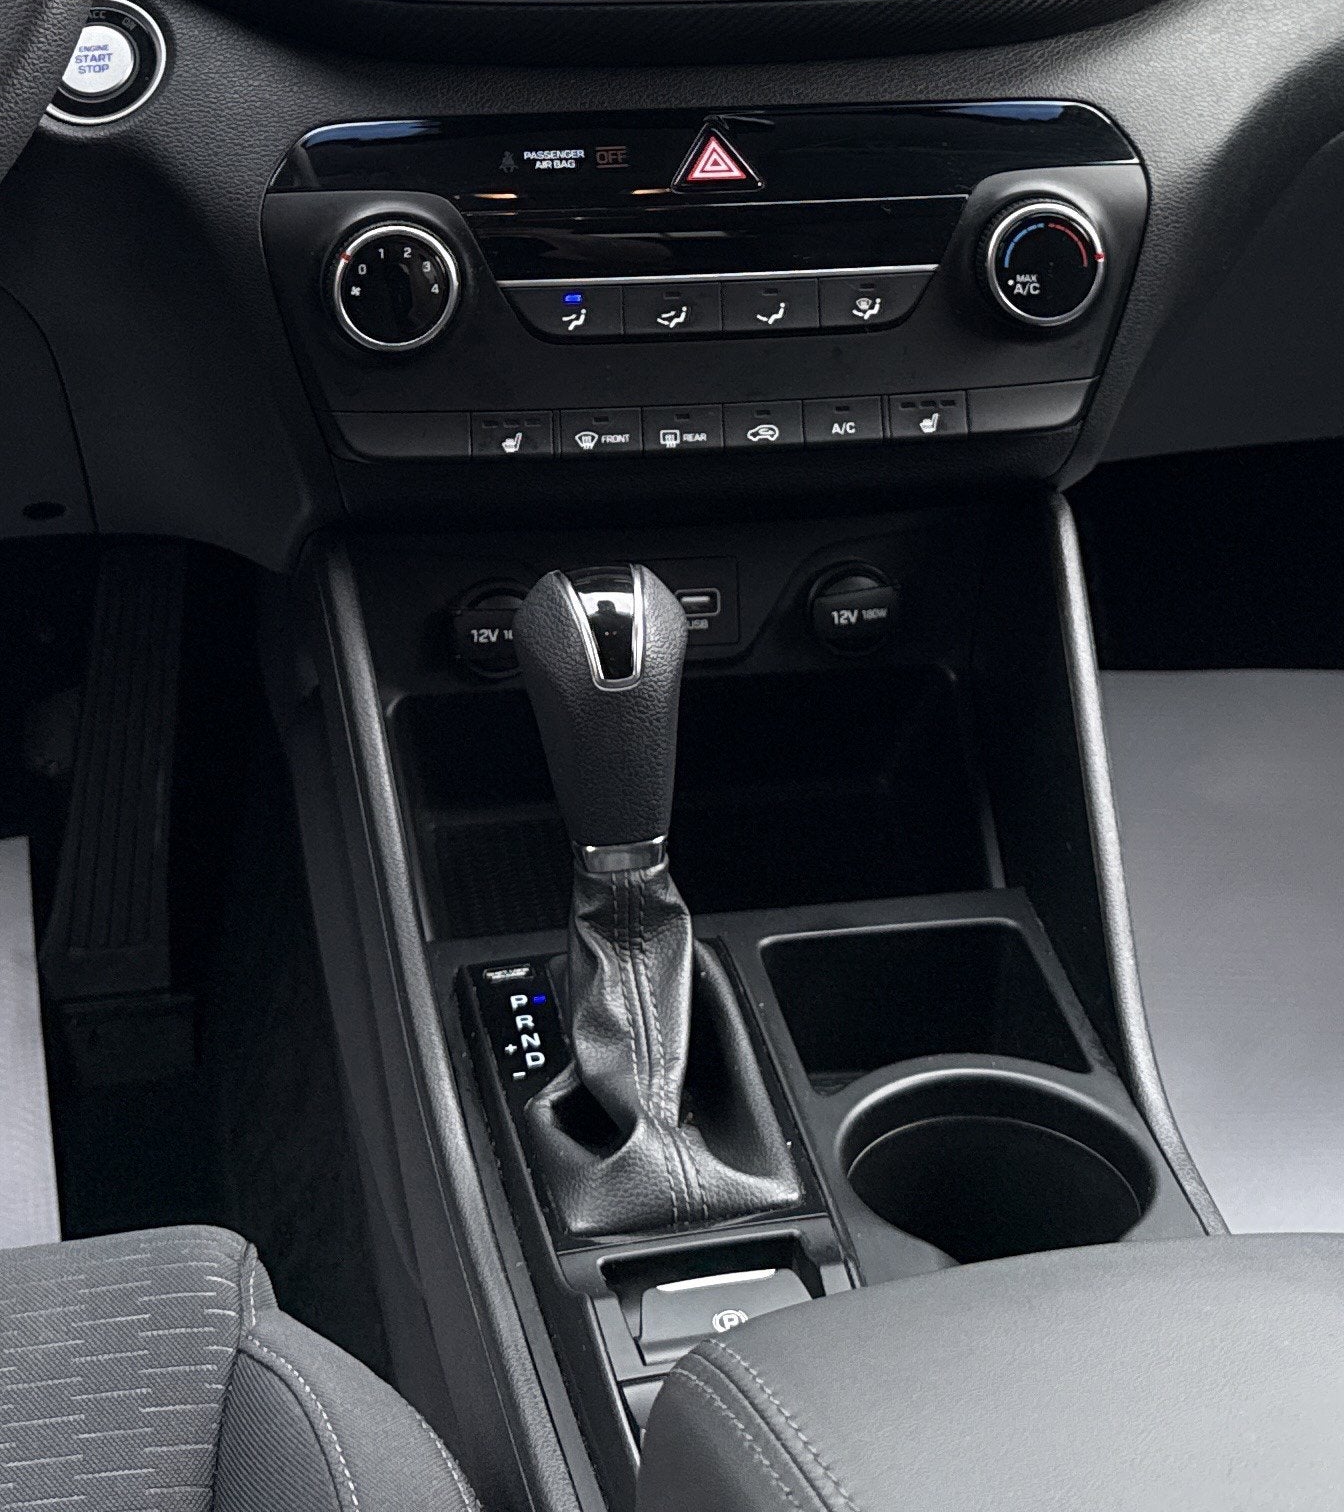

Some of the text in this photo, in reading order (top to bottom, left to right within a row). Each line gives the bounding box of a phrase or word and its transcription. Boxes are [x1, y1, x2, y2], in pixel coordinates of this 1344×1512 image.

[78, 44, 110, 53] ENGINE
[74, 53, 114, 64] START
[77, 63, 110, 75] STOP
[523, 149, 586, 160] PASSENGER
[595, 150, 626, 165] OFF
[534, 159, 576, 170] AIR BAG
[377, 247, 386, 260] 1
[402, 246, 412, 259] 2
[357, 263, 368, 276] 0
[421, 259, 432, 273] 3
[1015, 273, 1038, 284] MAX
[430, 282, 441, 295] 4
[1013, 282, 1042, 296] A/C
[831, 421, 857, 436] A/C
[600, 432, 631, 445] FRONT
[682, 431, 708, 443] REAR
[830, 609, 859, 626] 12V
[469, 627, 500, 644] 12V
[509, 994, 529, 1012] P
[515, 1014, 535, 1031] R
[520, 1032, 542, 1051] N
[525, 1051, 546, 1070] D
